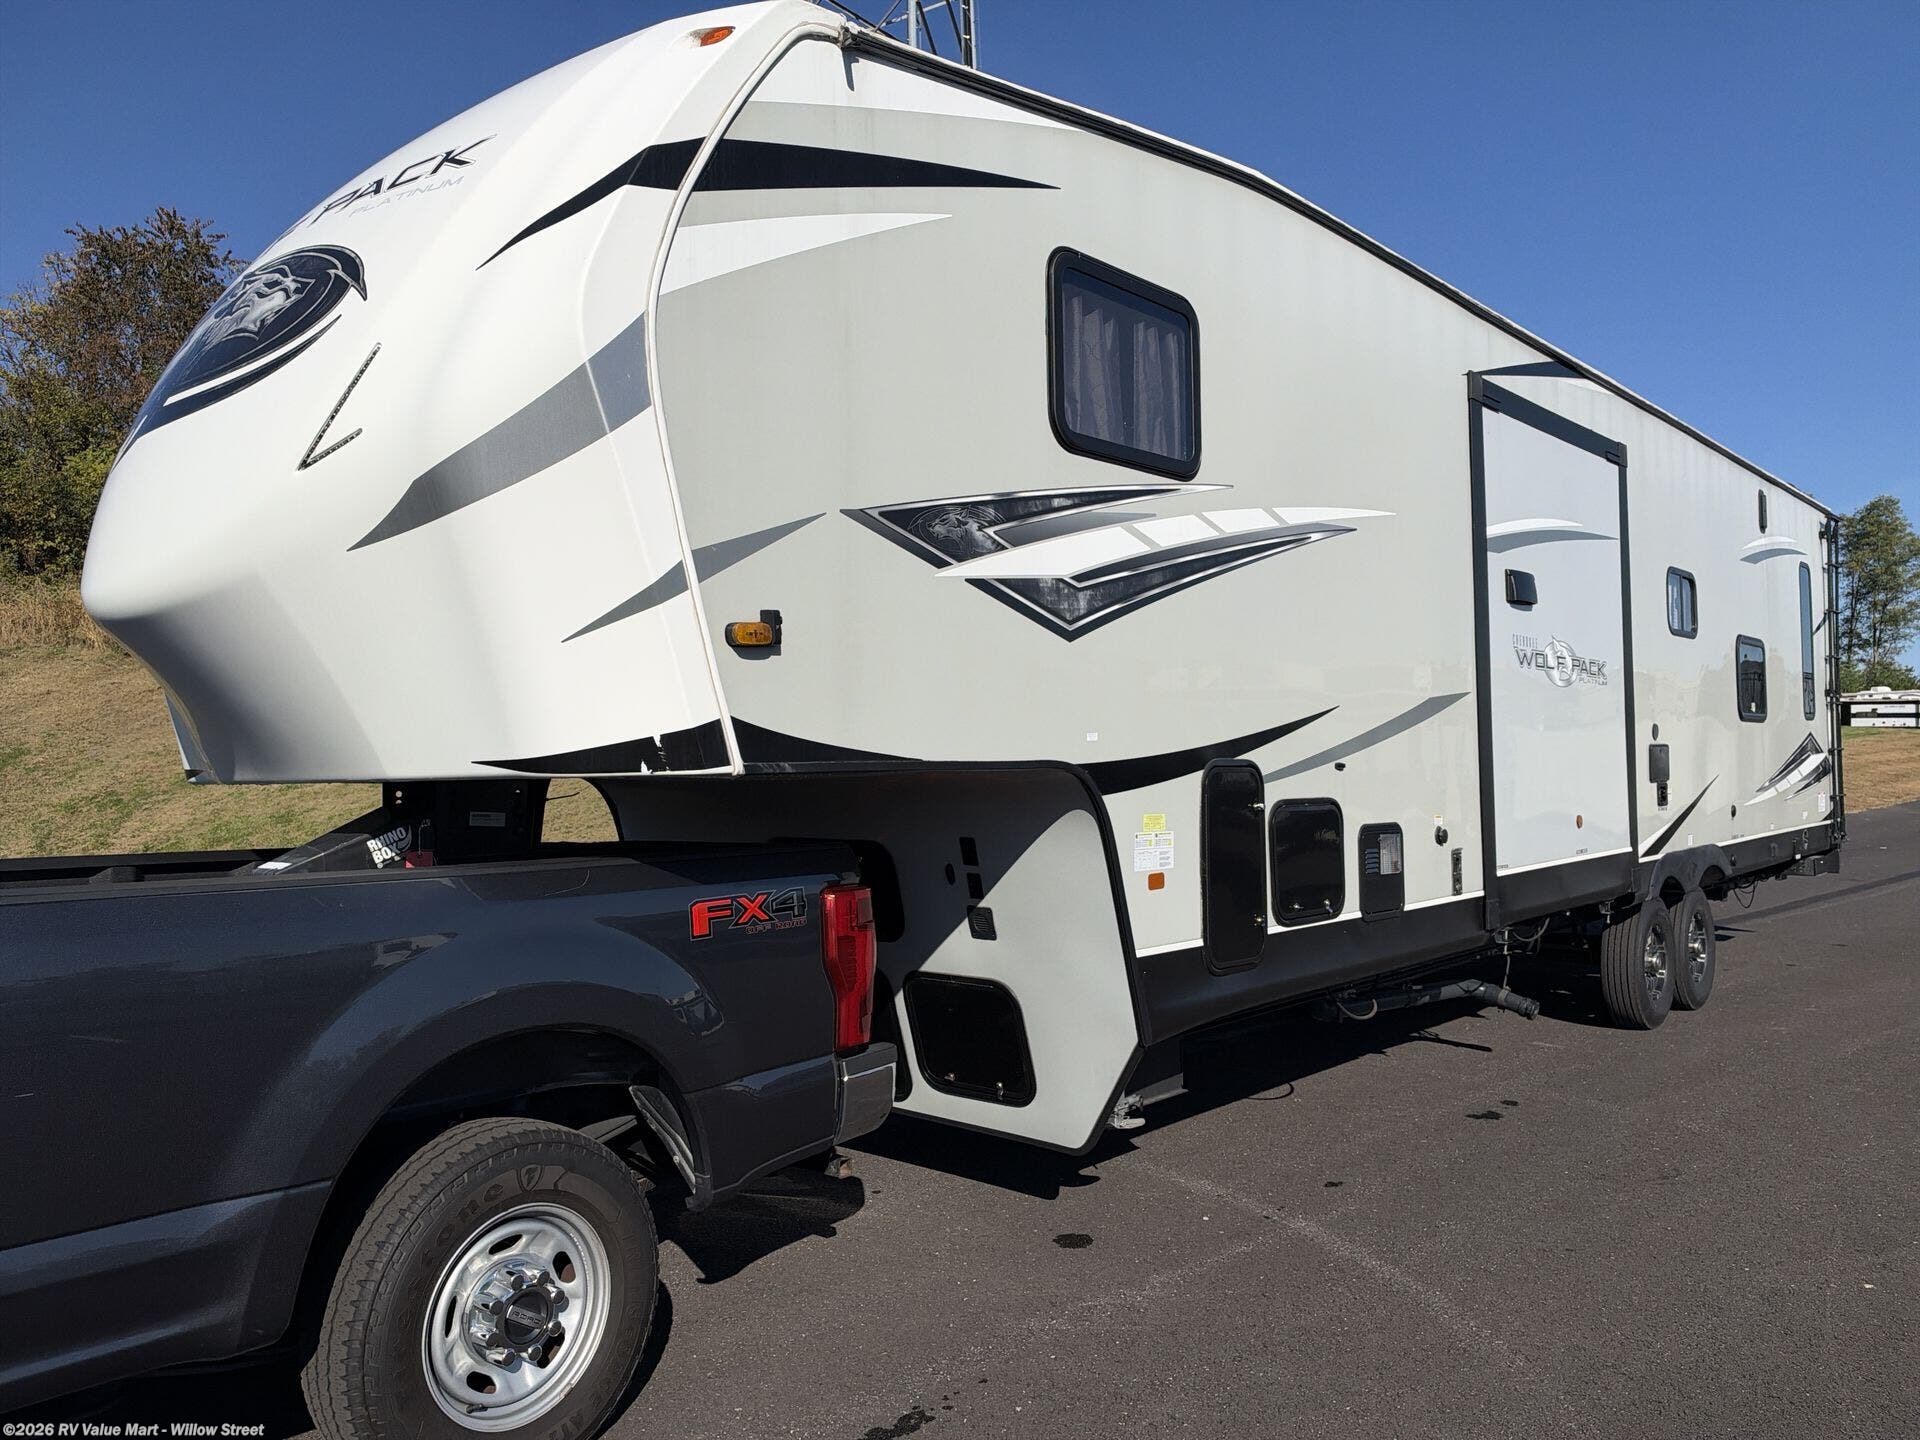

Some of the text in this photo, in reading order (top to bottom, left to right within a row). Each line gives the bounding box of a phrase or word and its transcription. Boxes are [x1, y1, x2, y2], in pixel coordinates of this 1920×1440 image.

[307, 134, 497, 228] PACK
[348, 175, 465, 217] PLATINUM
[366, 827, 407, 853] RHINO
[372, 842, 401, 864] BOX
[689, 887, 807, 941] FX4
